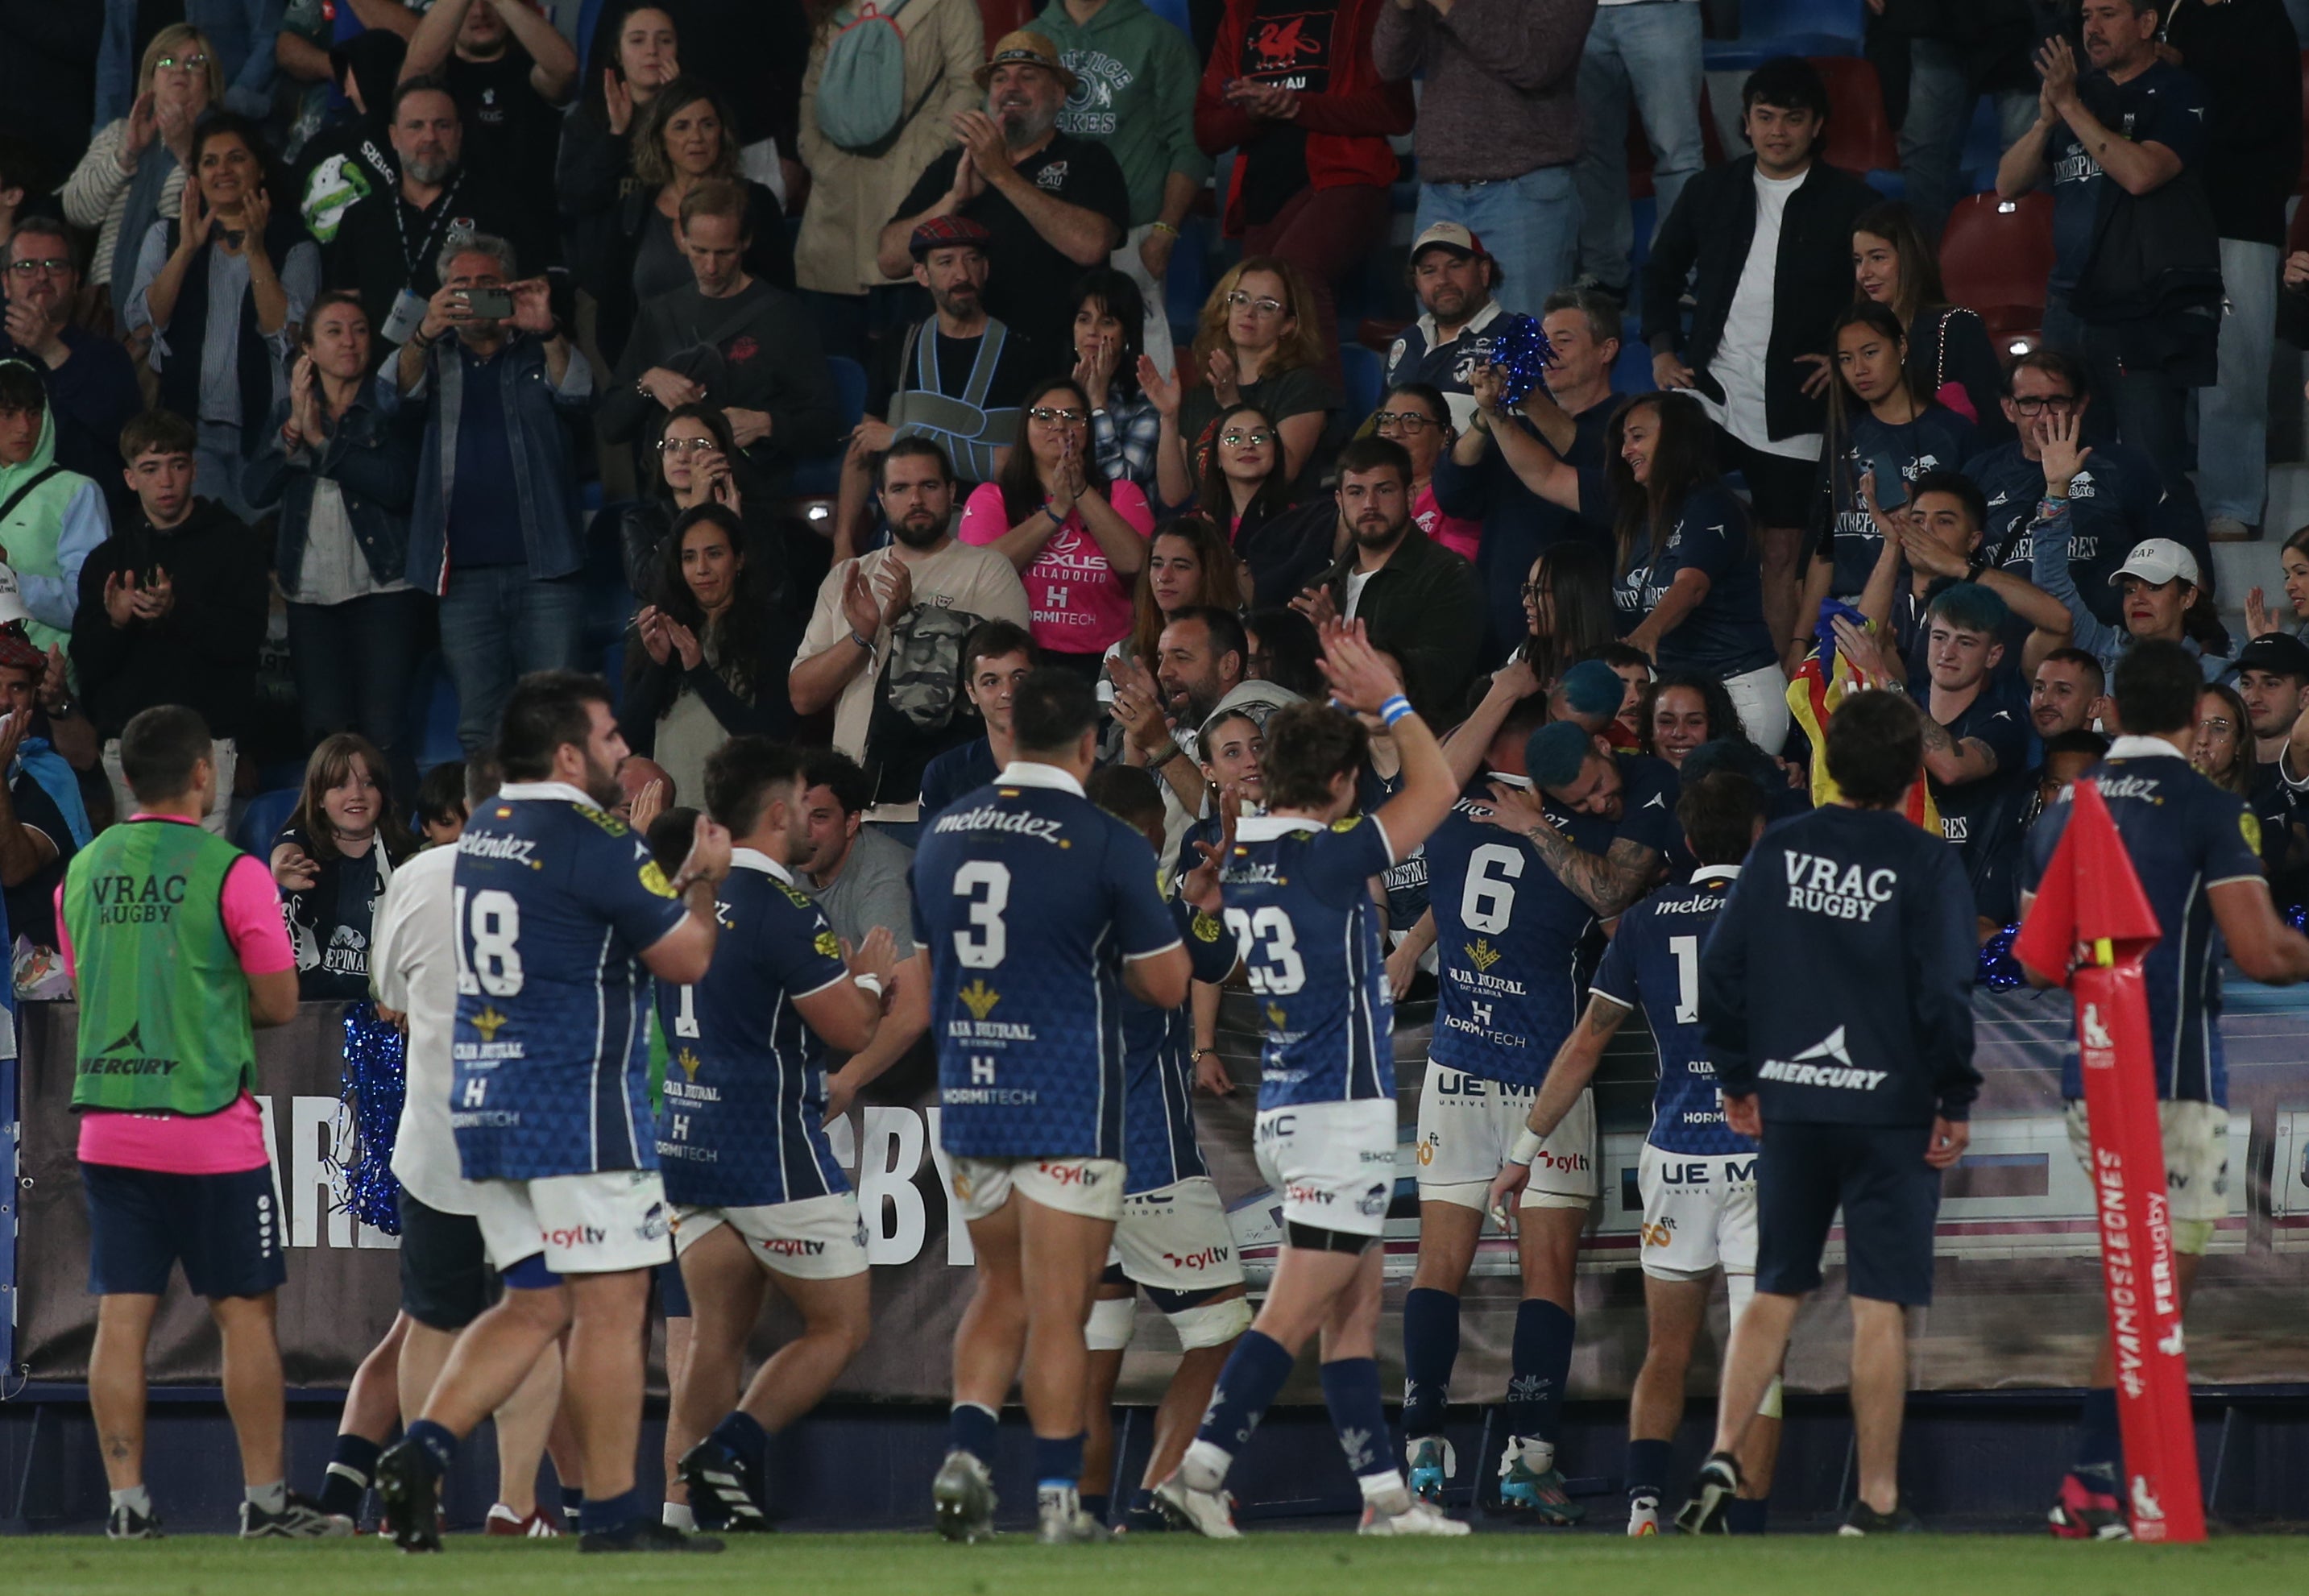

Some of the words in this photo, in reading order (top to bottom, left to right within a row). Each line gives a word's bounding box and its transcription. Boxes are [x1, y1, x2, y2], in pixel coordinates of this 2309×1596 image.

[2068, 486, 2096, 499] RAC
[1034, 552, 1109, 570] EXUS
[1025, 566, 1106, 583] LLADOLID
[1030, 610, 1096, 625] RMITECH
[934, 804, 1063, 844] meléndez
[1941, 815, 1967, 839] RES
[1784, 849, 1897, 902] VRAC
[92, 875, 187, 903] VRAC
[1461, 843, 1525, 935] 6
[101, 905, 172, 925] RUGBY
[953, 860, 1011, 969] 3
[1786, 885, 1877, 922] RUGBY
[1757, 1059, 1888, 1091] MERCURY
[1660, 1217, 1677, 1230] fit
[553, 1225, 606, 1249] cyltv
[1186, 1246, 1229, 1271] cyltv
[2145, 1191, 2175, 1316] FERugby
